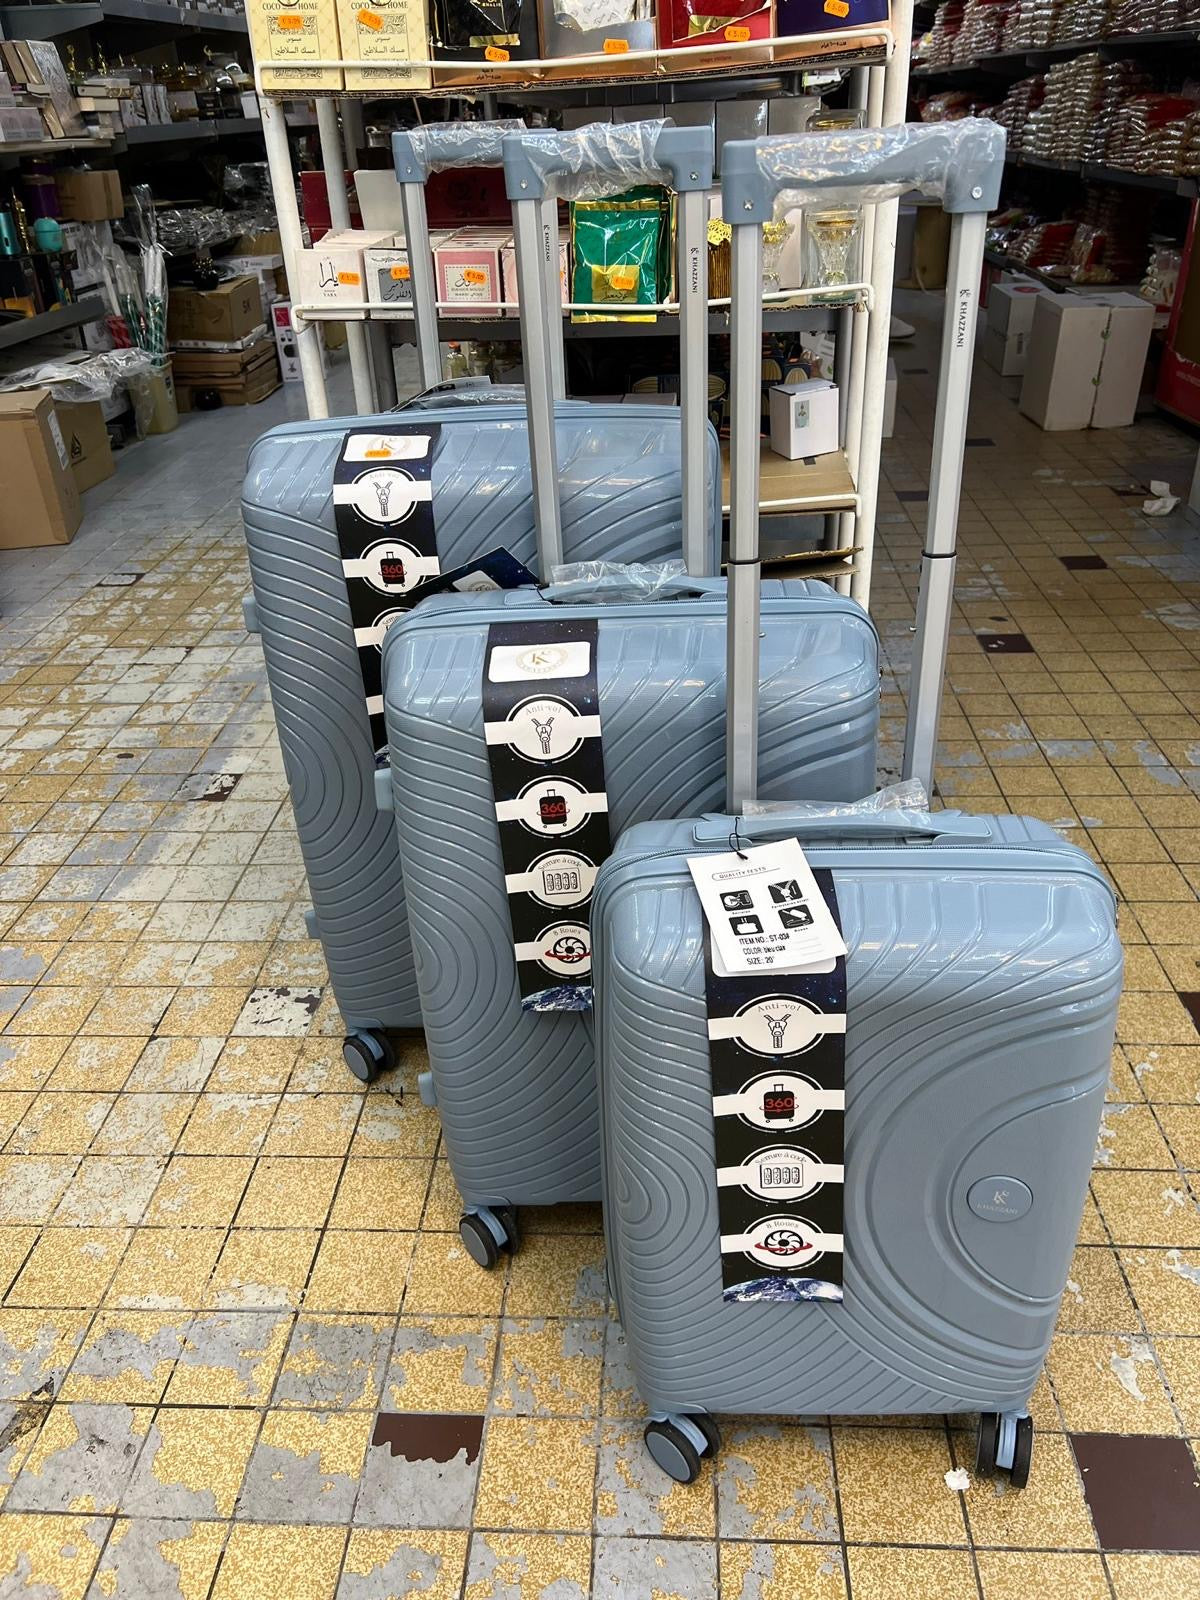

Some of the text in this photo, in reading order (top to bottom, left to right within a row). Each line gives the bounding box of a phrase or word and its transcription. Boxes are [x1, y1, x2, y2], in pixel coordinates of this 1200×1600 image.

[262, 2, 319, 10] COCO HOME
[351, 2, 370, 10] COCO
[956, 301, 968, 348] KHAZZANI
[718, 871, 746, 879] QUALITY
[757, 1002, 802, 1013] Anti-vol
